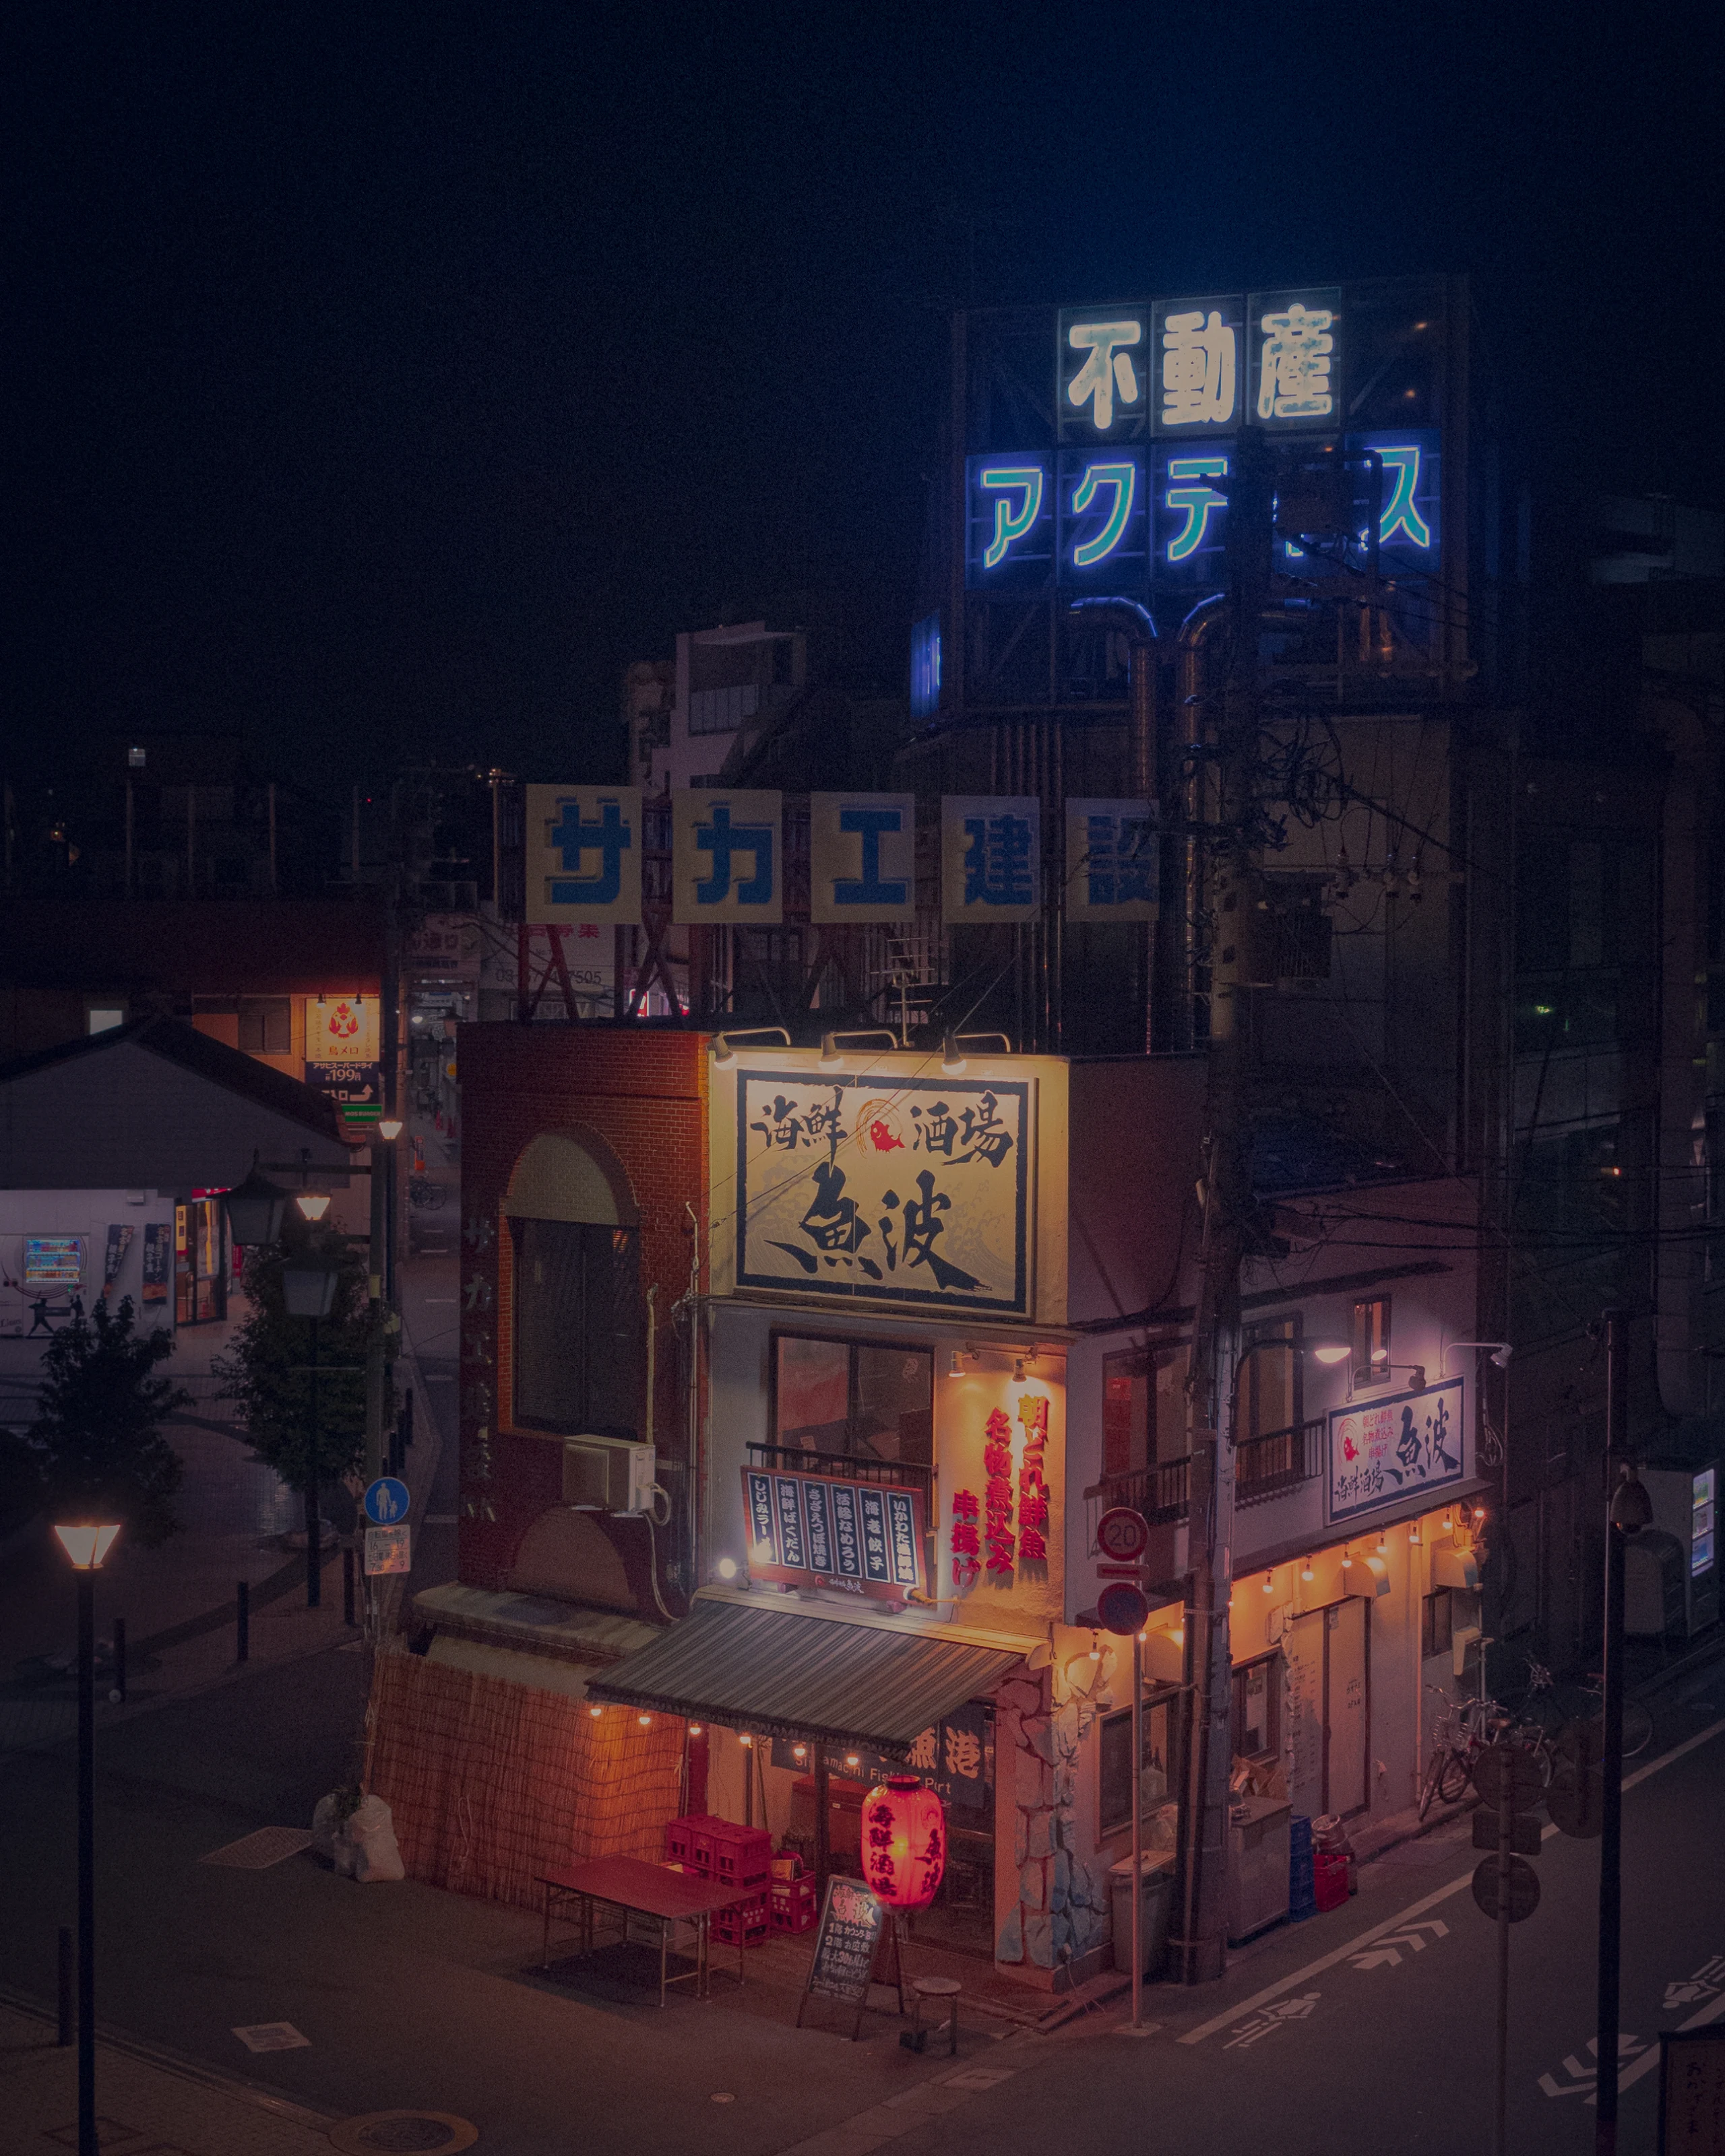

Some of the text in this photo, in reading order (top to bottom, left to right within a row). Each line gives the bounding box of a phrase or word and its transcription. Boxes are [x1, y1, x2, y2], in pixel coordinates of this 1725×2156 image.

[1067, 303, 1334, 430] 不動産
[980, 445, 1431, 569] アクテス
[544, 796, 1157, 906] サカエ建設
[328, 1046, 358, 1055] 鳥メロ
[751, 1085, 1014, 1178] 海鮮 酒場
[763, 1162, 993, 1292] 魚波
[1018, 1394, 1050, 1559] 朝どれ鮮魚
[1334, 1460, 1385, 1503] 海鮮酒場
[1383, 1397, 1461, 1485] 魚波
[780, 1484, 800, 1562] 海鮮ばくだん
[865, 1500, 885, 1572] 海老餃子
[984, 1407, 1015, 1574] 名物煮込み
[1110, 1525, 1137, 1548] 20
[951, 1489, 981, 1588] 串揚げ
[869, 1804, 897, 1897] 海鮮酒場
[914, 1829, 942, 1896] 魚波
